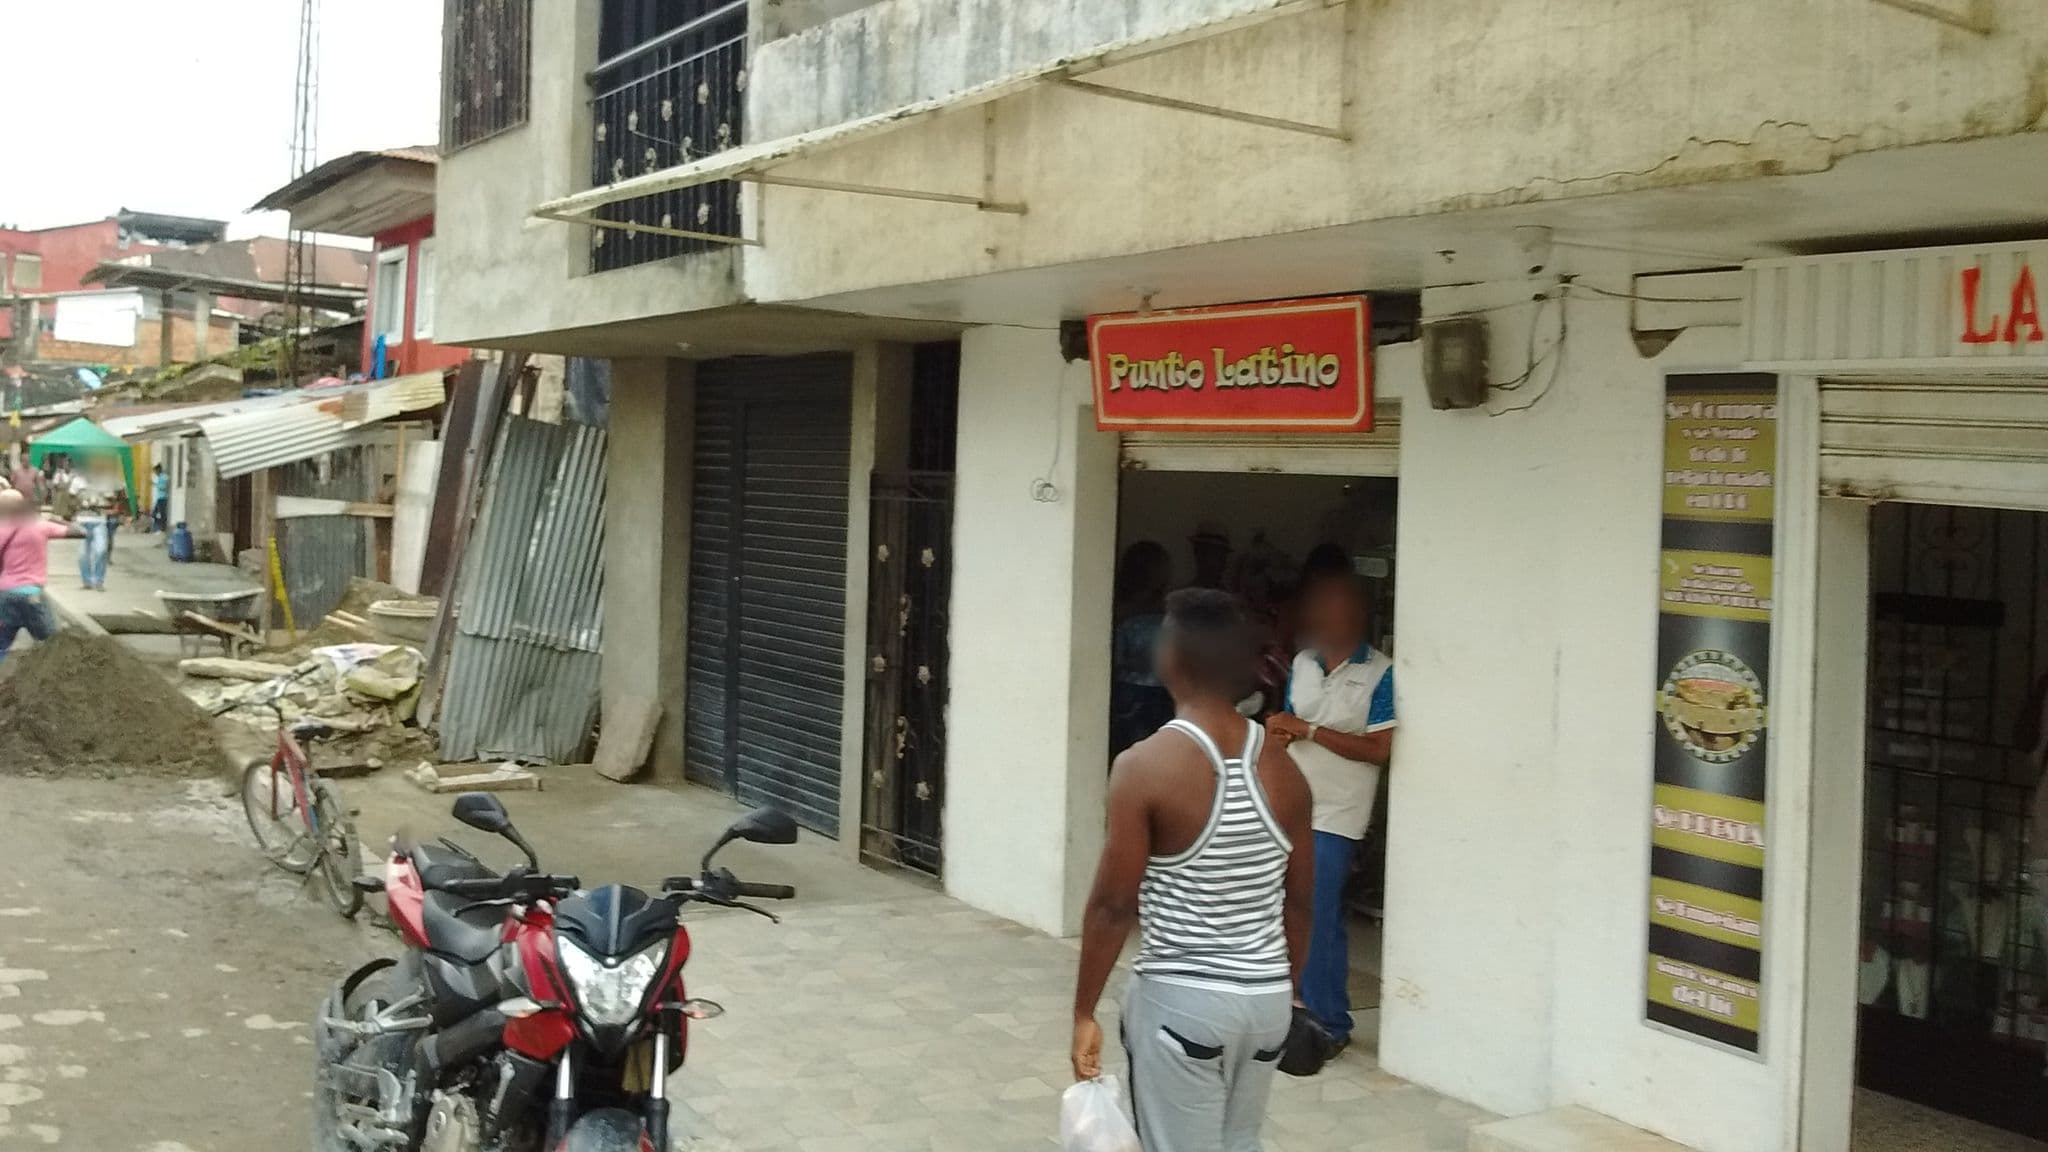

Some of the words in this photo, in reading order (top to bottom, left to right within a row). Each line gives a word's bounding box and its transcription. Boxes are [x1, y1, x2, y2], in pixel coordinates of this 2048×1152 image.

[1960, 264, 2044, 344] LA
[1107, 351, 1206, 391] Punto
[1212, 343, 1340, 390] Latino
